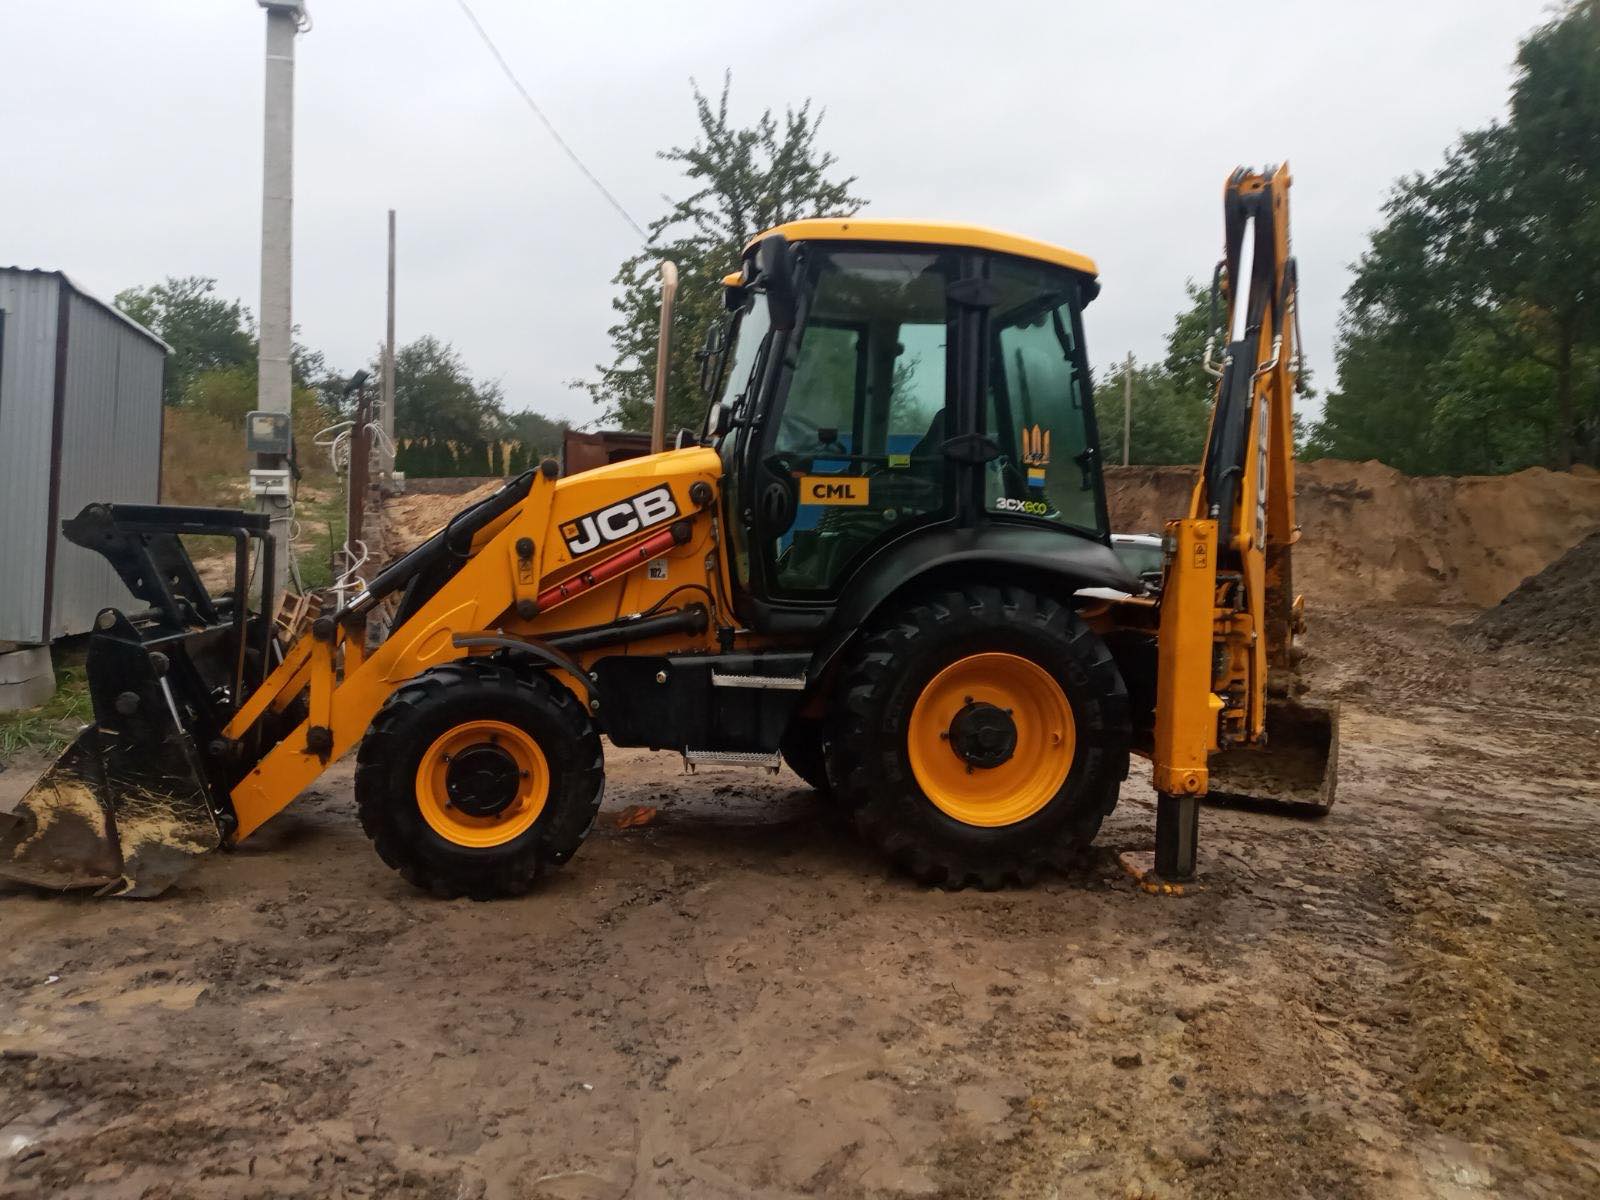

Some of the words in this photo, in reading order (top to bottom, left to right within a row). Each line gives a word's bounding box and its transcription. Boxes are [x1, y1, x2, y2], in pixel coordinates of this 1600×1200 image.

[812, 484, 856, 499] CML
[996, 497, 1047, 515] 3CXeco
[569, 488, 677, 554] JCB
